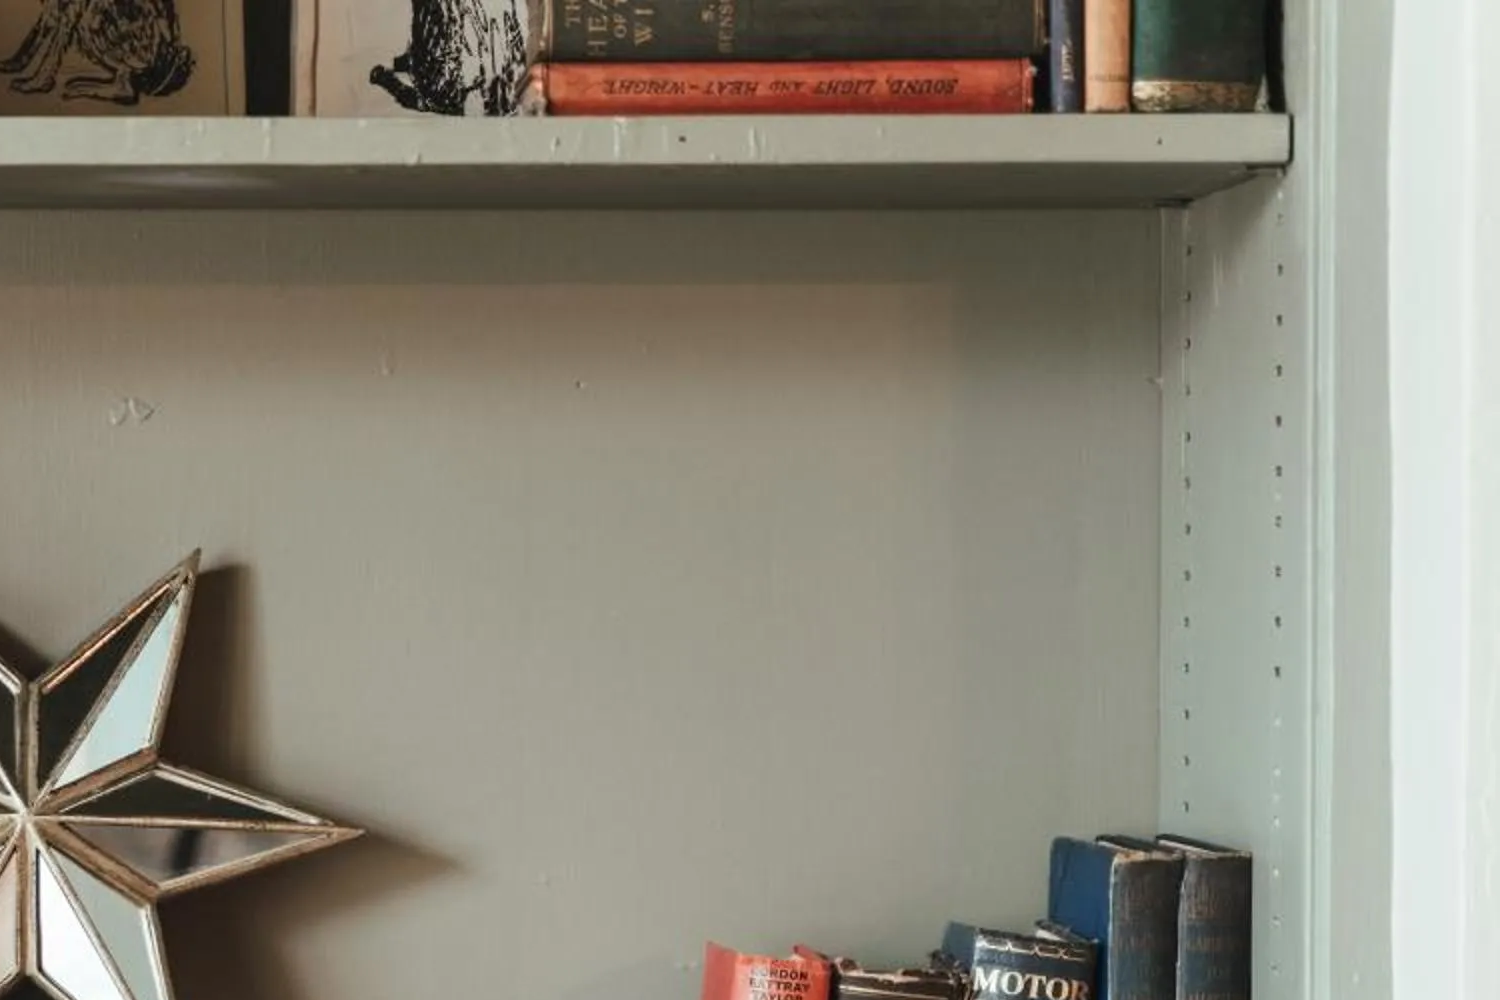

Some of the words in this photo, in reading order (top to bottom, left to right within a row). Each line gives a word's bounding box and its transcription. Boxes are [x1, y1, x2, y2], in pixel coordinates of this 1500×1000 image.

[634, 8, 654, 47] WI
[768, 80, 804, 95] AND
[812, 79, 877, 96] LIGHT
[750, 968, 809, 982] RDON
